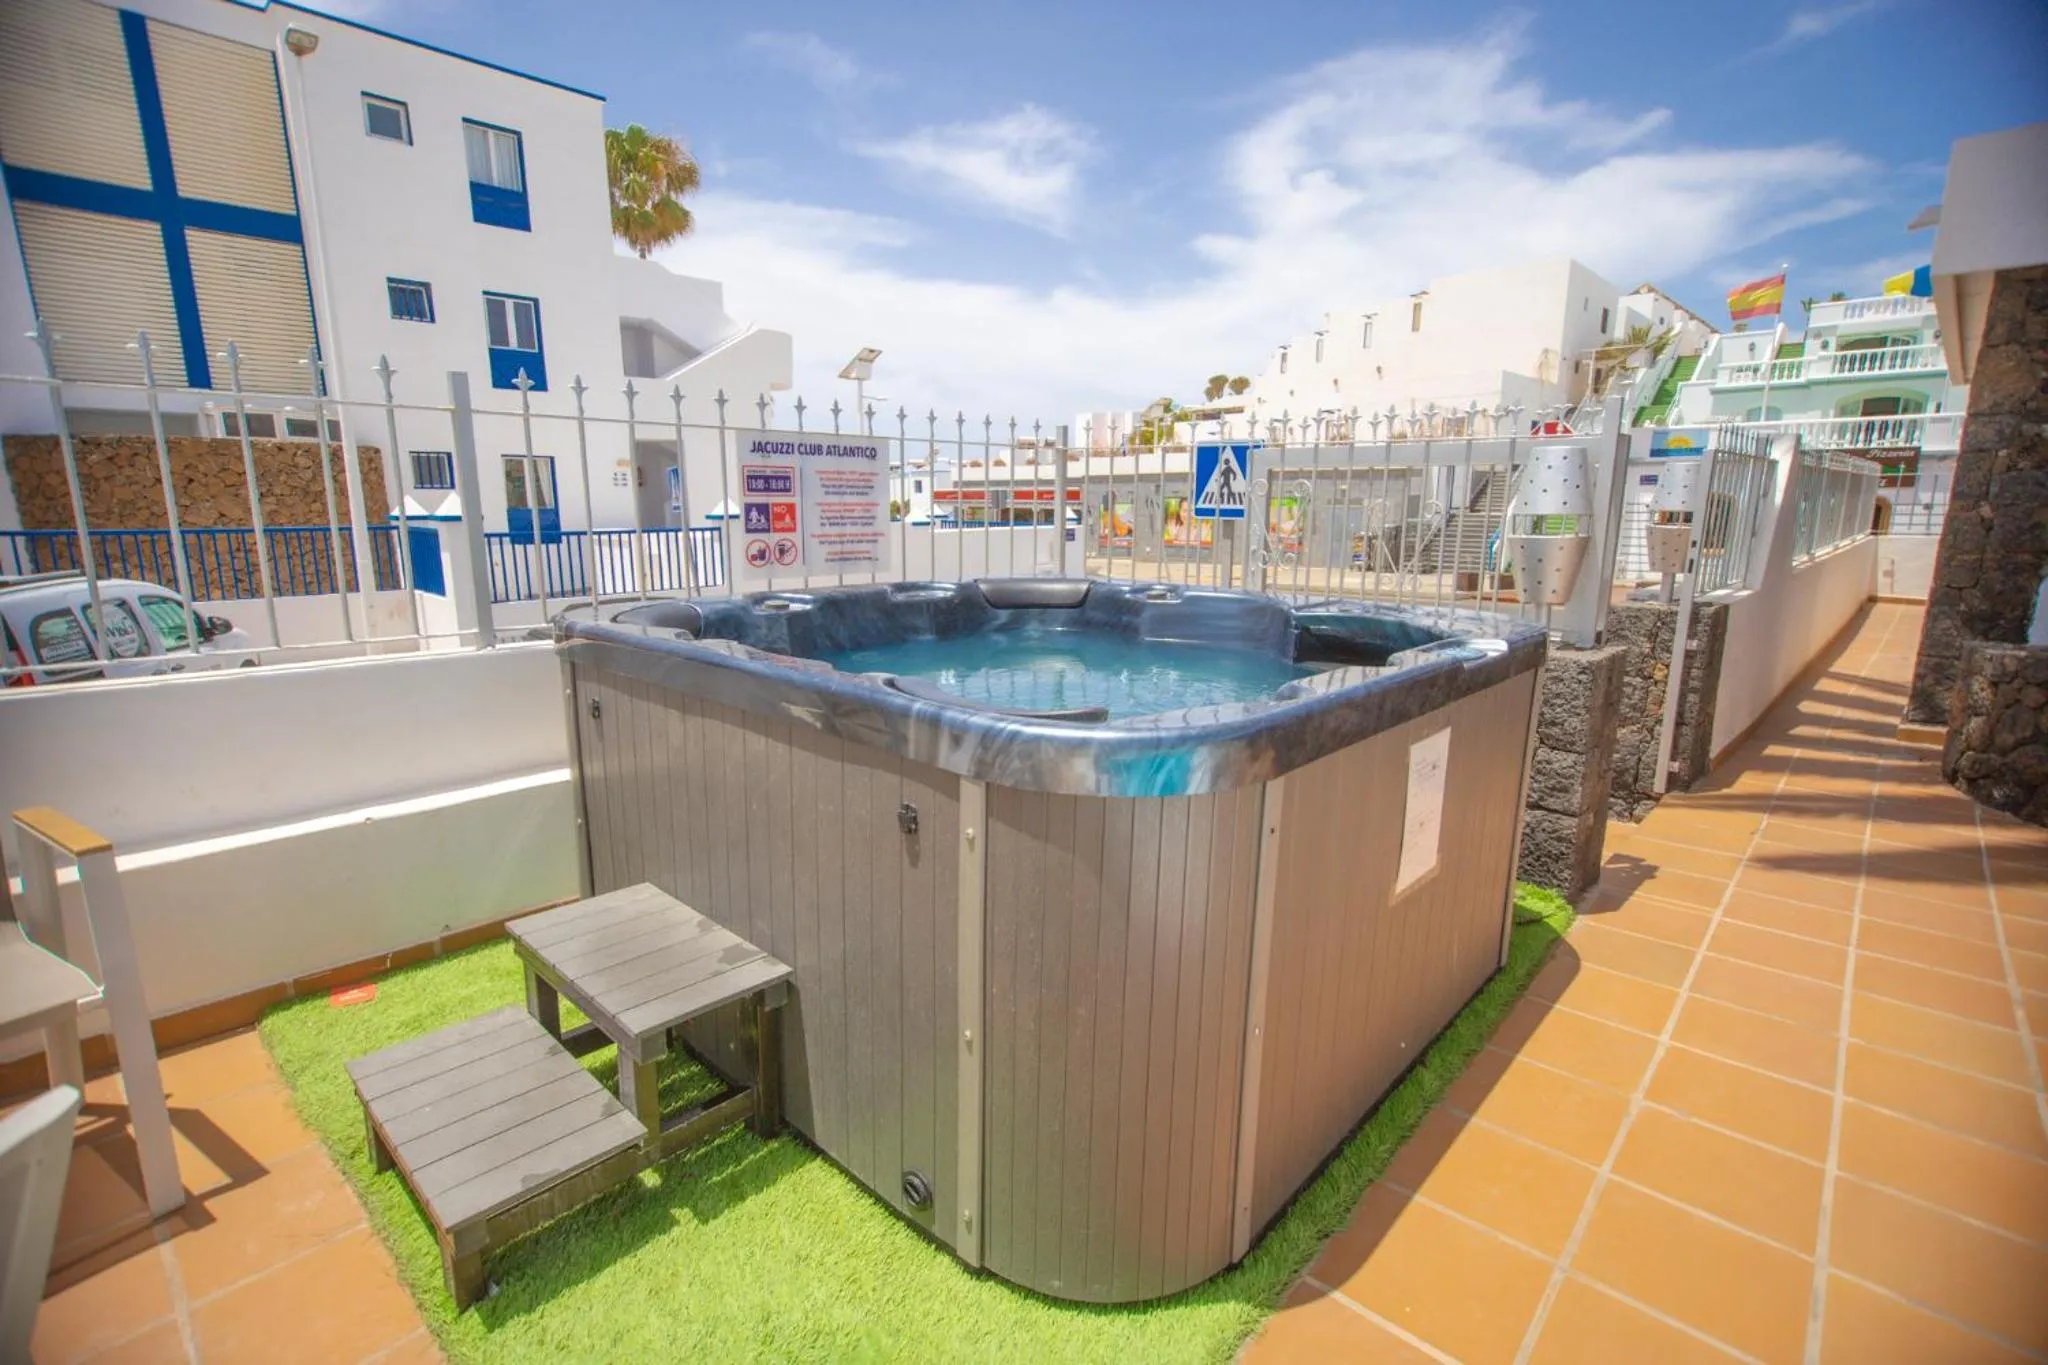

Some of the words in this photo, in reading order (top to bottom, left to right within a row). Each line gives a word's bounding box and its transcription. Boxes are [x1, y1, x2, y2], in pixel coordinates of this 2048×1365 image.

[750, 440, 795, 455] JACUZZI
[797, 442, 824, 456] CLUB
[825, 444, 878, 461] ATLANTICO
